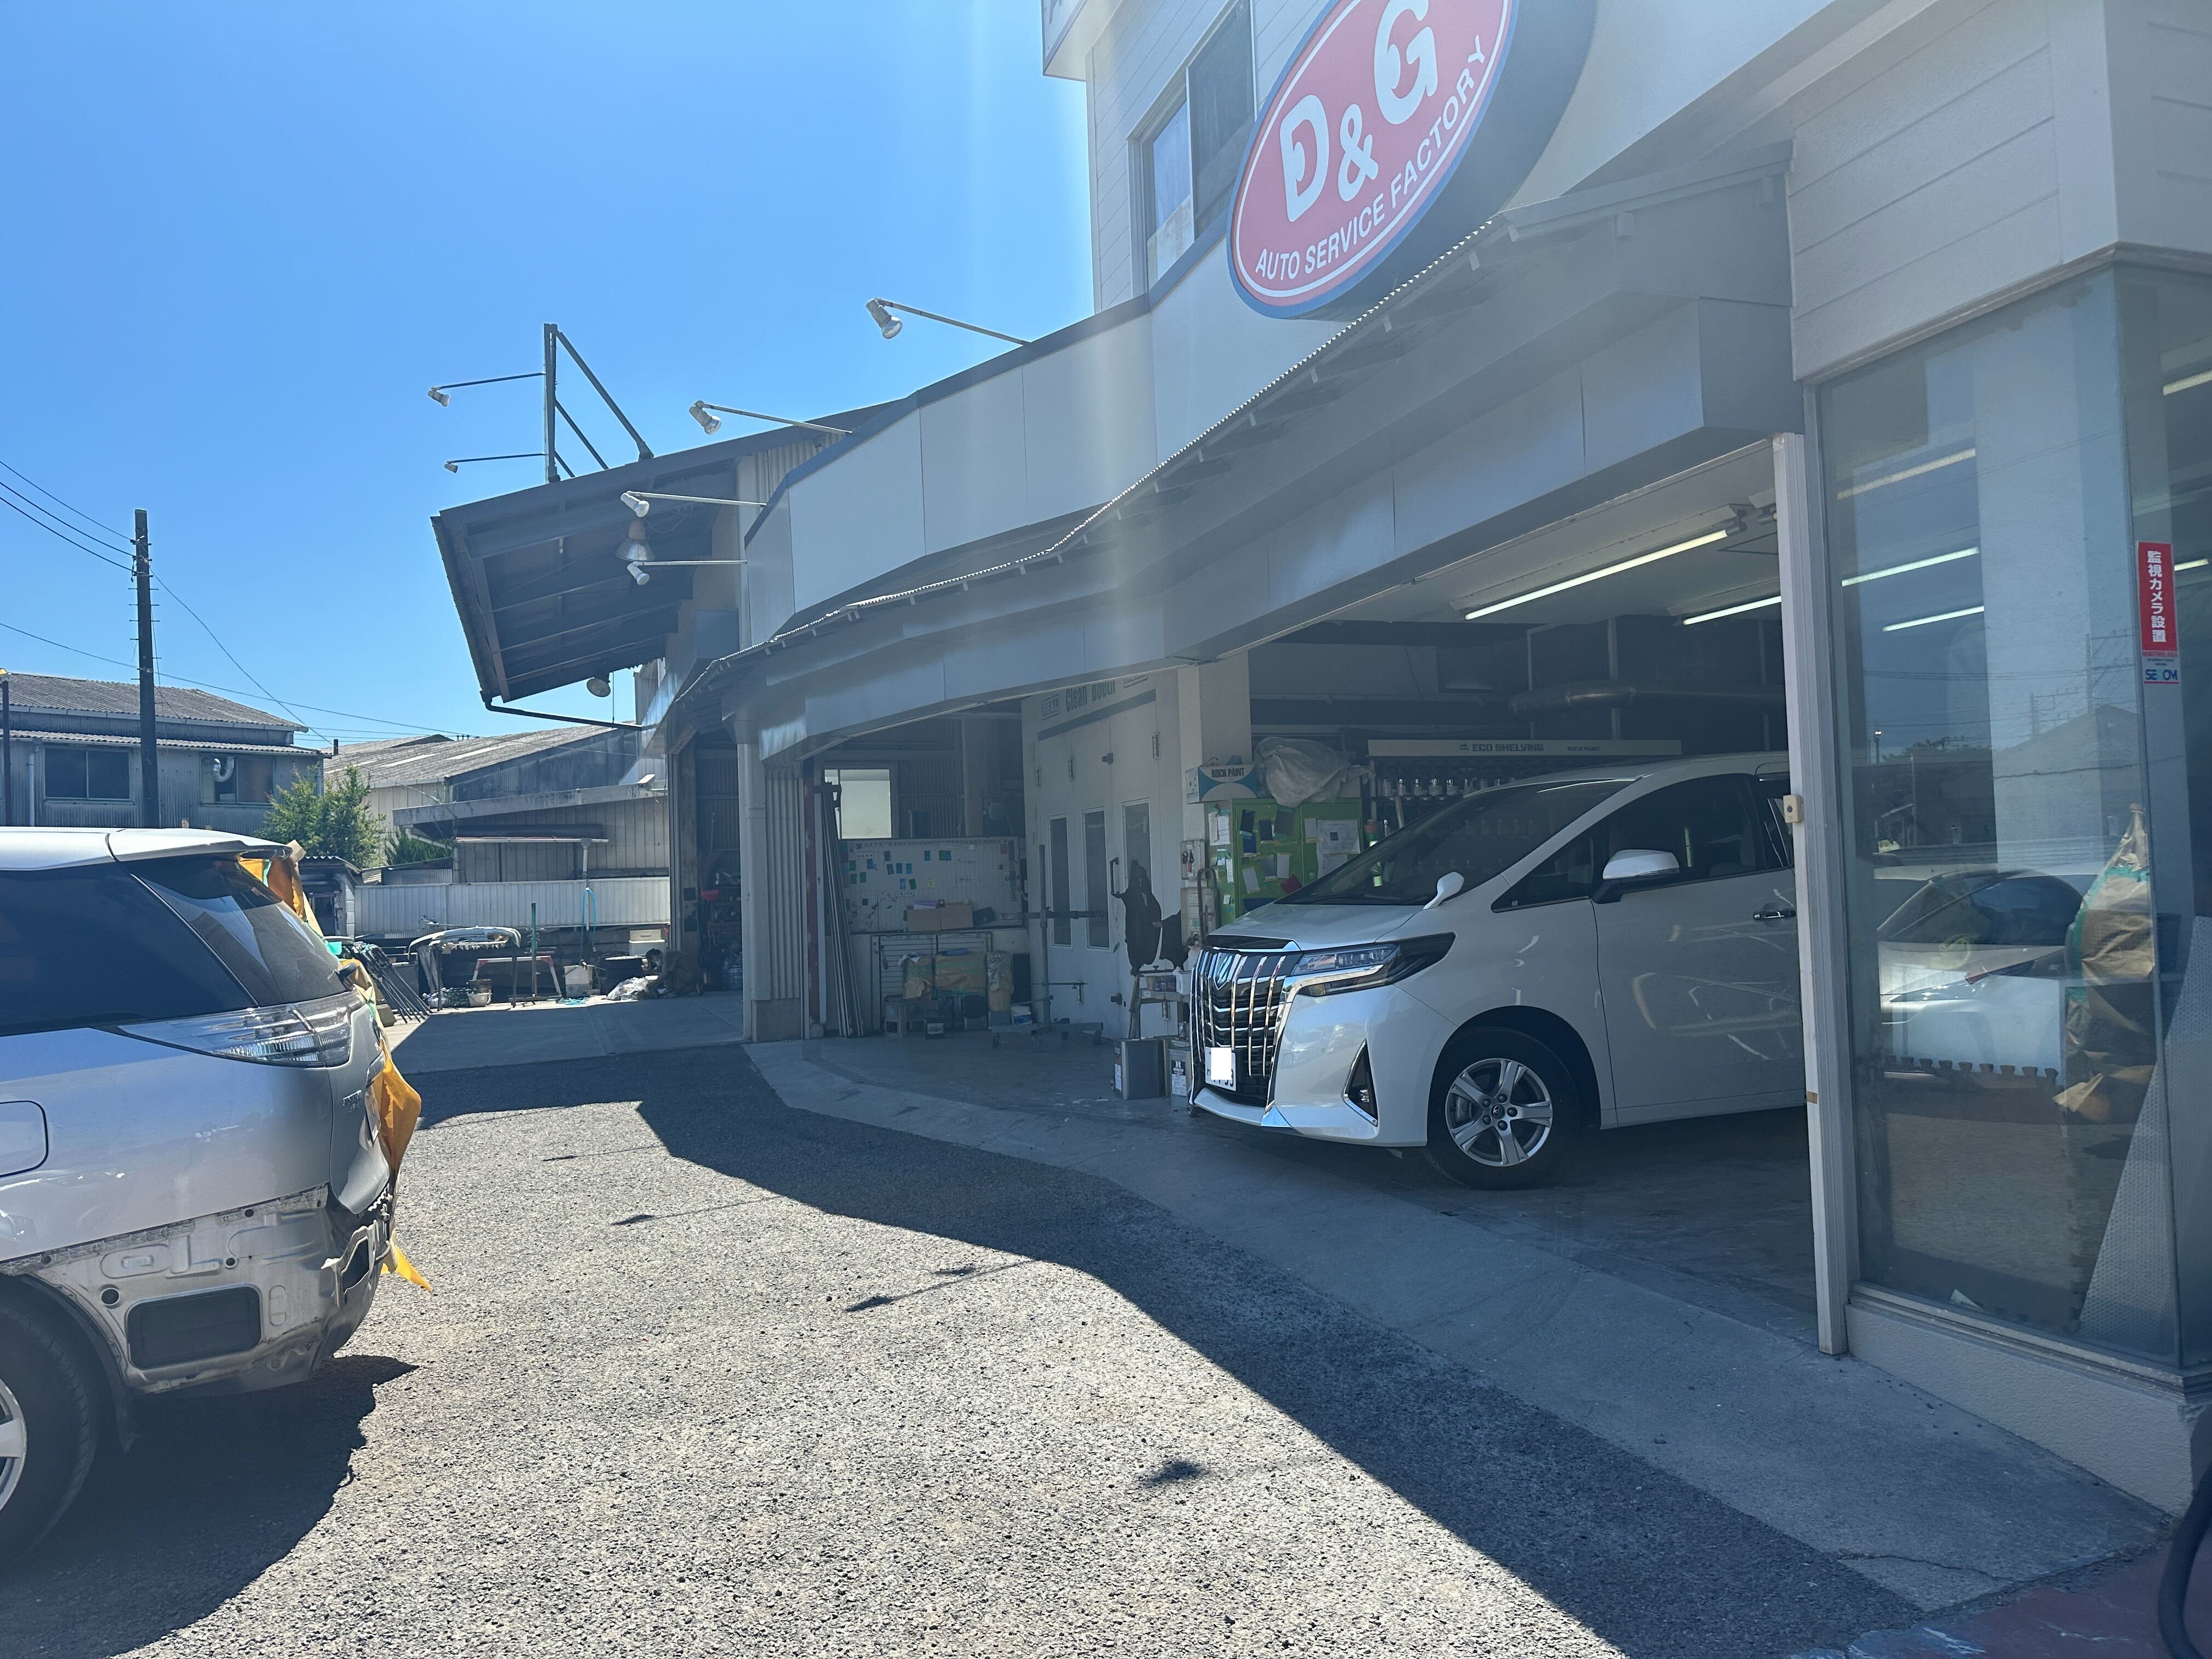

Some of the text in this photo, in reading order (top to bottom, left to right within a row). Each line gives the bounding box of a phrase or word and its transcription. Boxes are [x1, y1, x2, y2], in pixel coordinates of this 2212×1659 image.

[1255, 34, 1486, 281] AUTO SERVICE FACTORY
[2147, 550, 2167, 642] 監視カメラ設置
[1065, 685, 1087, 712] Clean
[1472, 743, 1544, 752] ECO SHELVING
[1211, 768, 1245, 778] ROCK PAINT
